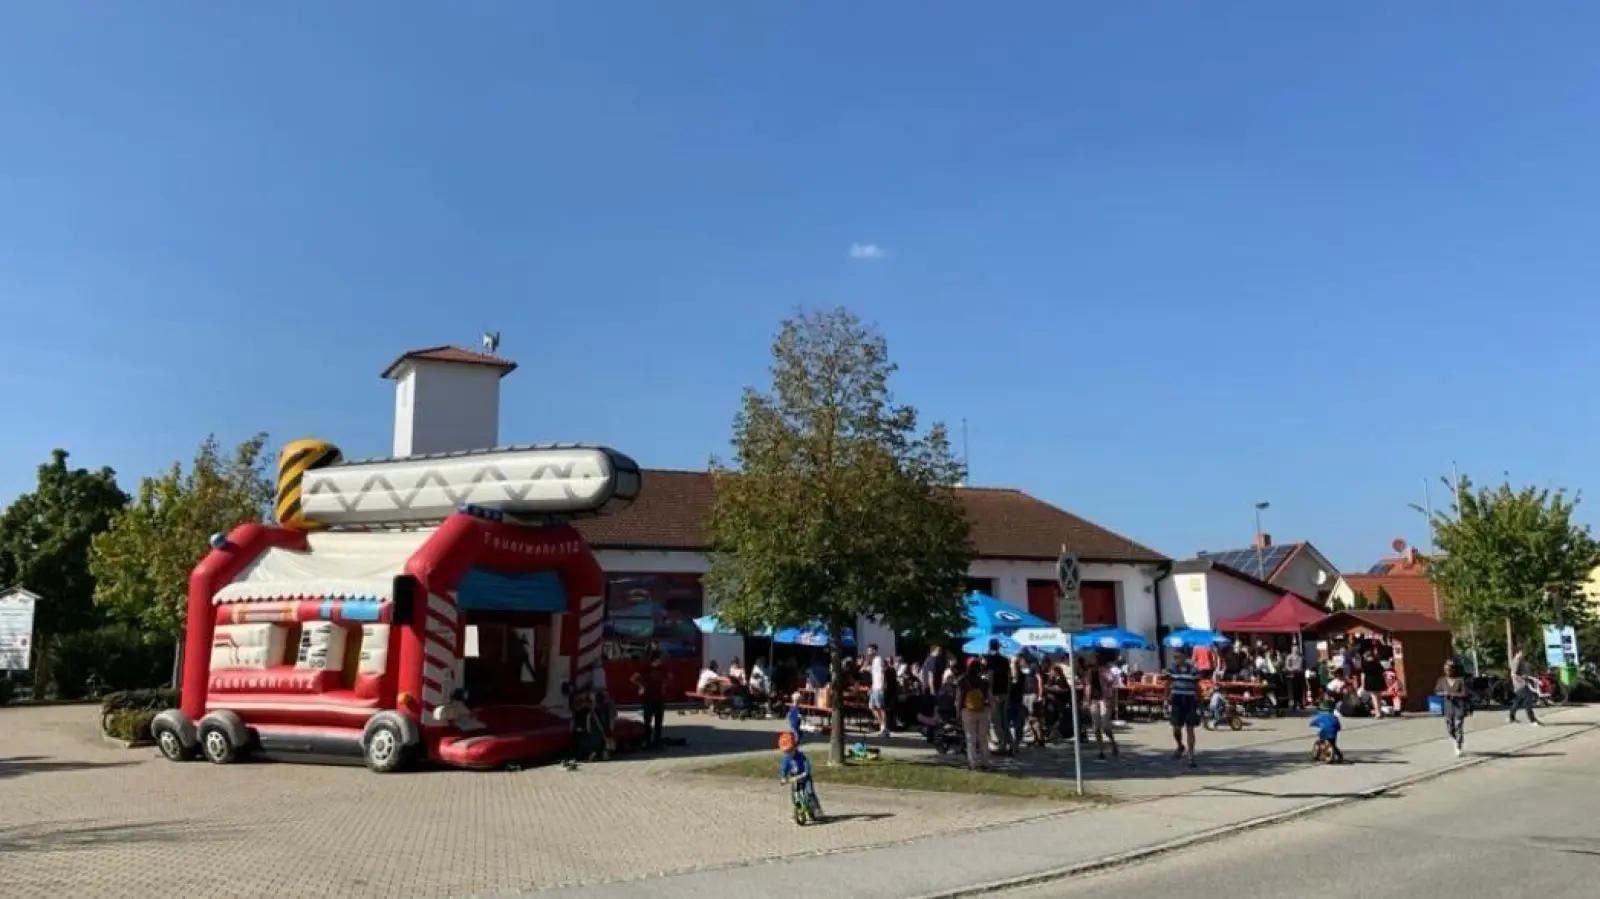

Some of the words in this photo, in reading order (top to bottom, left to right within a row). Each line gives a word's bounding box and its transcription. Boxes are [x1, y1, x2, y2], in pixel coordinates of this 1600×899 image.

[485, 532, 555, 555] Feuerwehr
[559, 541, 579, 553] 112
[208, 676, 281, 688] Feuerwehr
